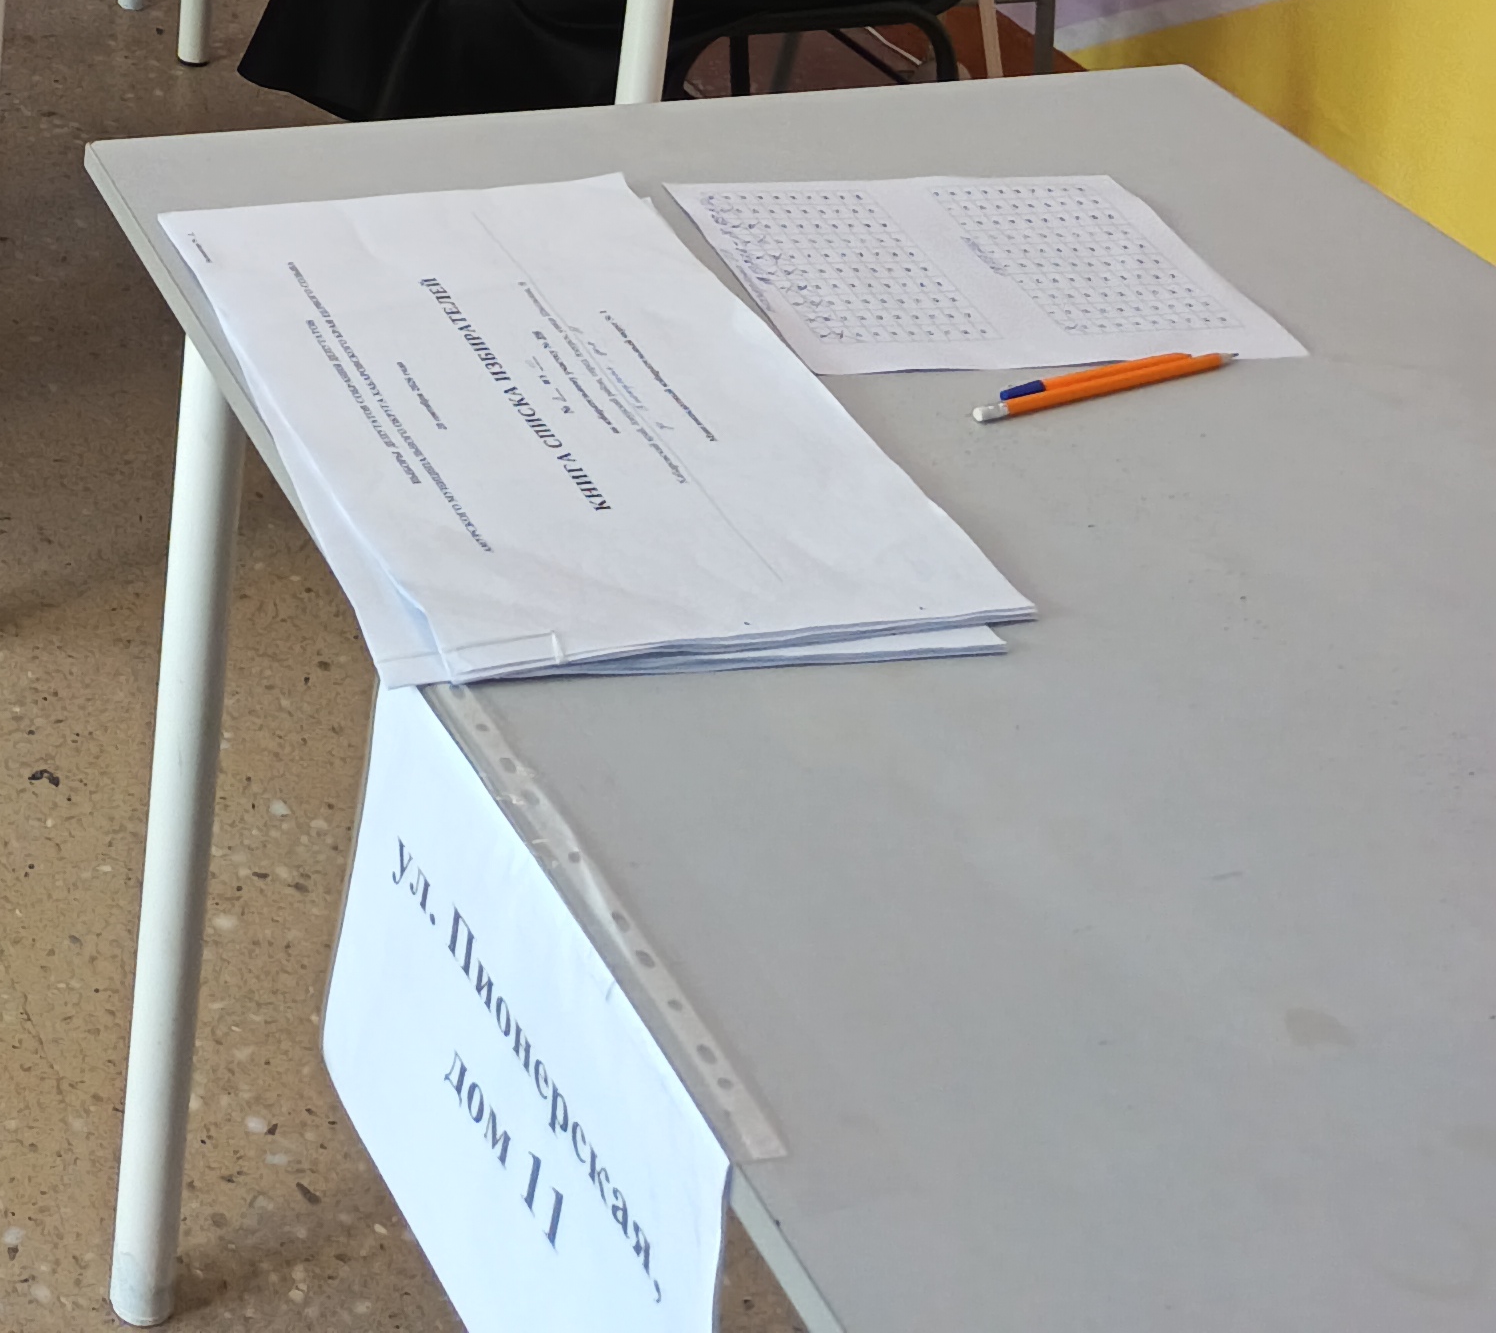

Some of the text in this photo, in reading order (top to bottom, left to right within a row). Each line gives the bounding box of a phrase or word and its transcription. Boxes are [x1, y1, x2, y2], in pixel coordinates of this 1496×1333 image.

[420, 278, 610, 510] КНИГА СПИСКА ИЗБИРАТЕЛЕЙ
[391, 835, 664, 1305] ул. Пионерская,
[442, 1049, 566, 1253] дом 11
